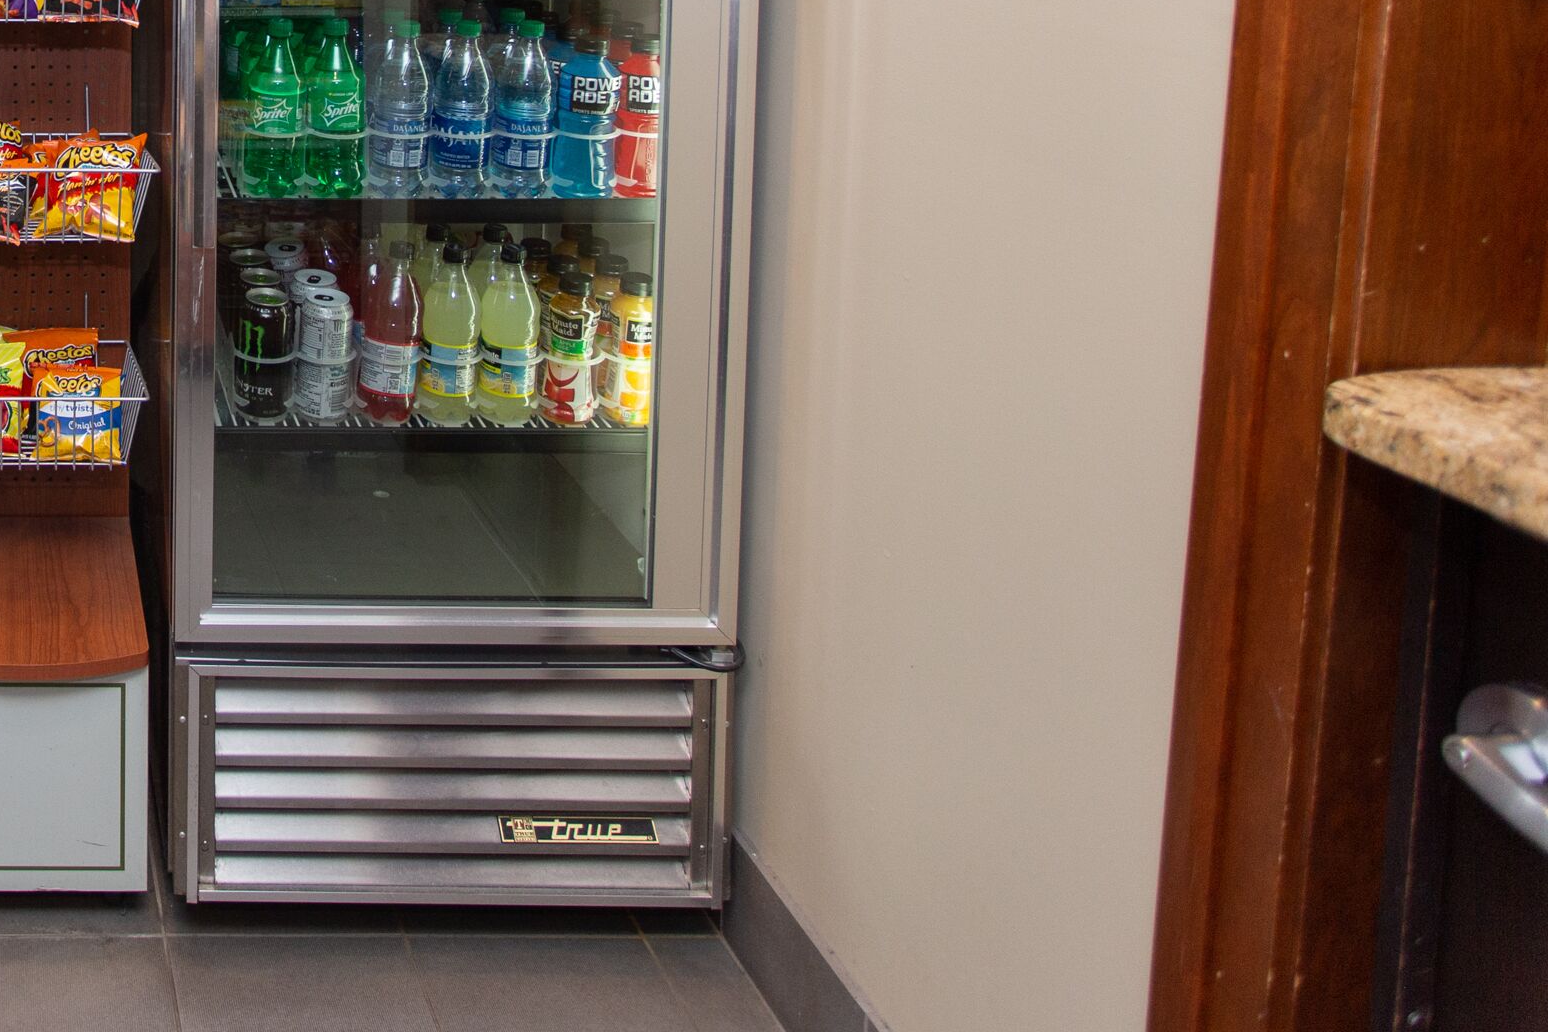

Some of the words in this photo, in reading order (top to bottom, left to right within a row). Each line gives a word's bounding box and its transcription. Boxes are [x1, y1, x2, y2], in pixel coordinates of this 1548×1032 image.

[573, 89, 607, 104] ADE
[254, 107, 287, 121] Sprite
[324, 102, 358, 118] Sprite
[0, 148, 18, 161] Hot
[56, 144, 133, 178] Cheetos
[27, 344, 93, 367] Cheetos
[547, 819, 637, 840] true
